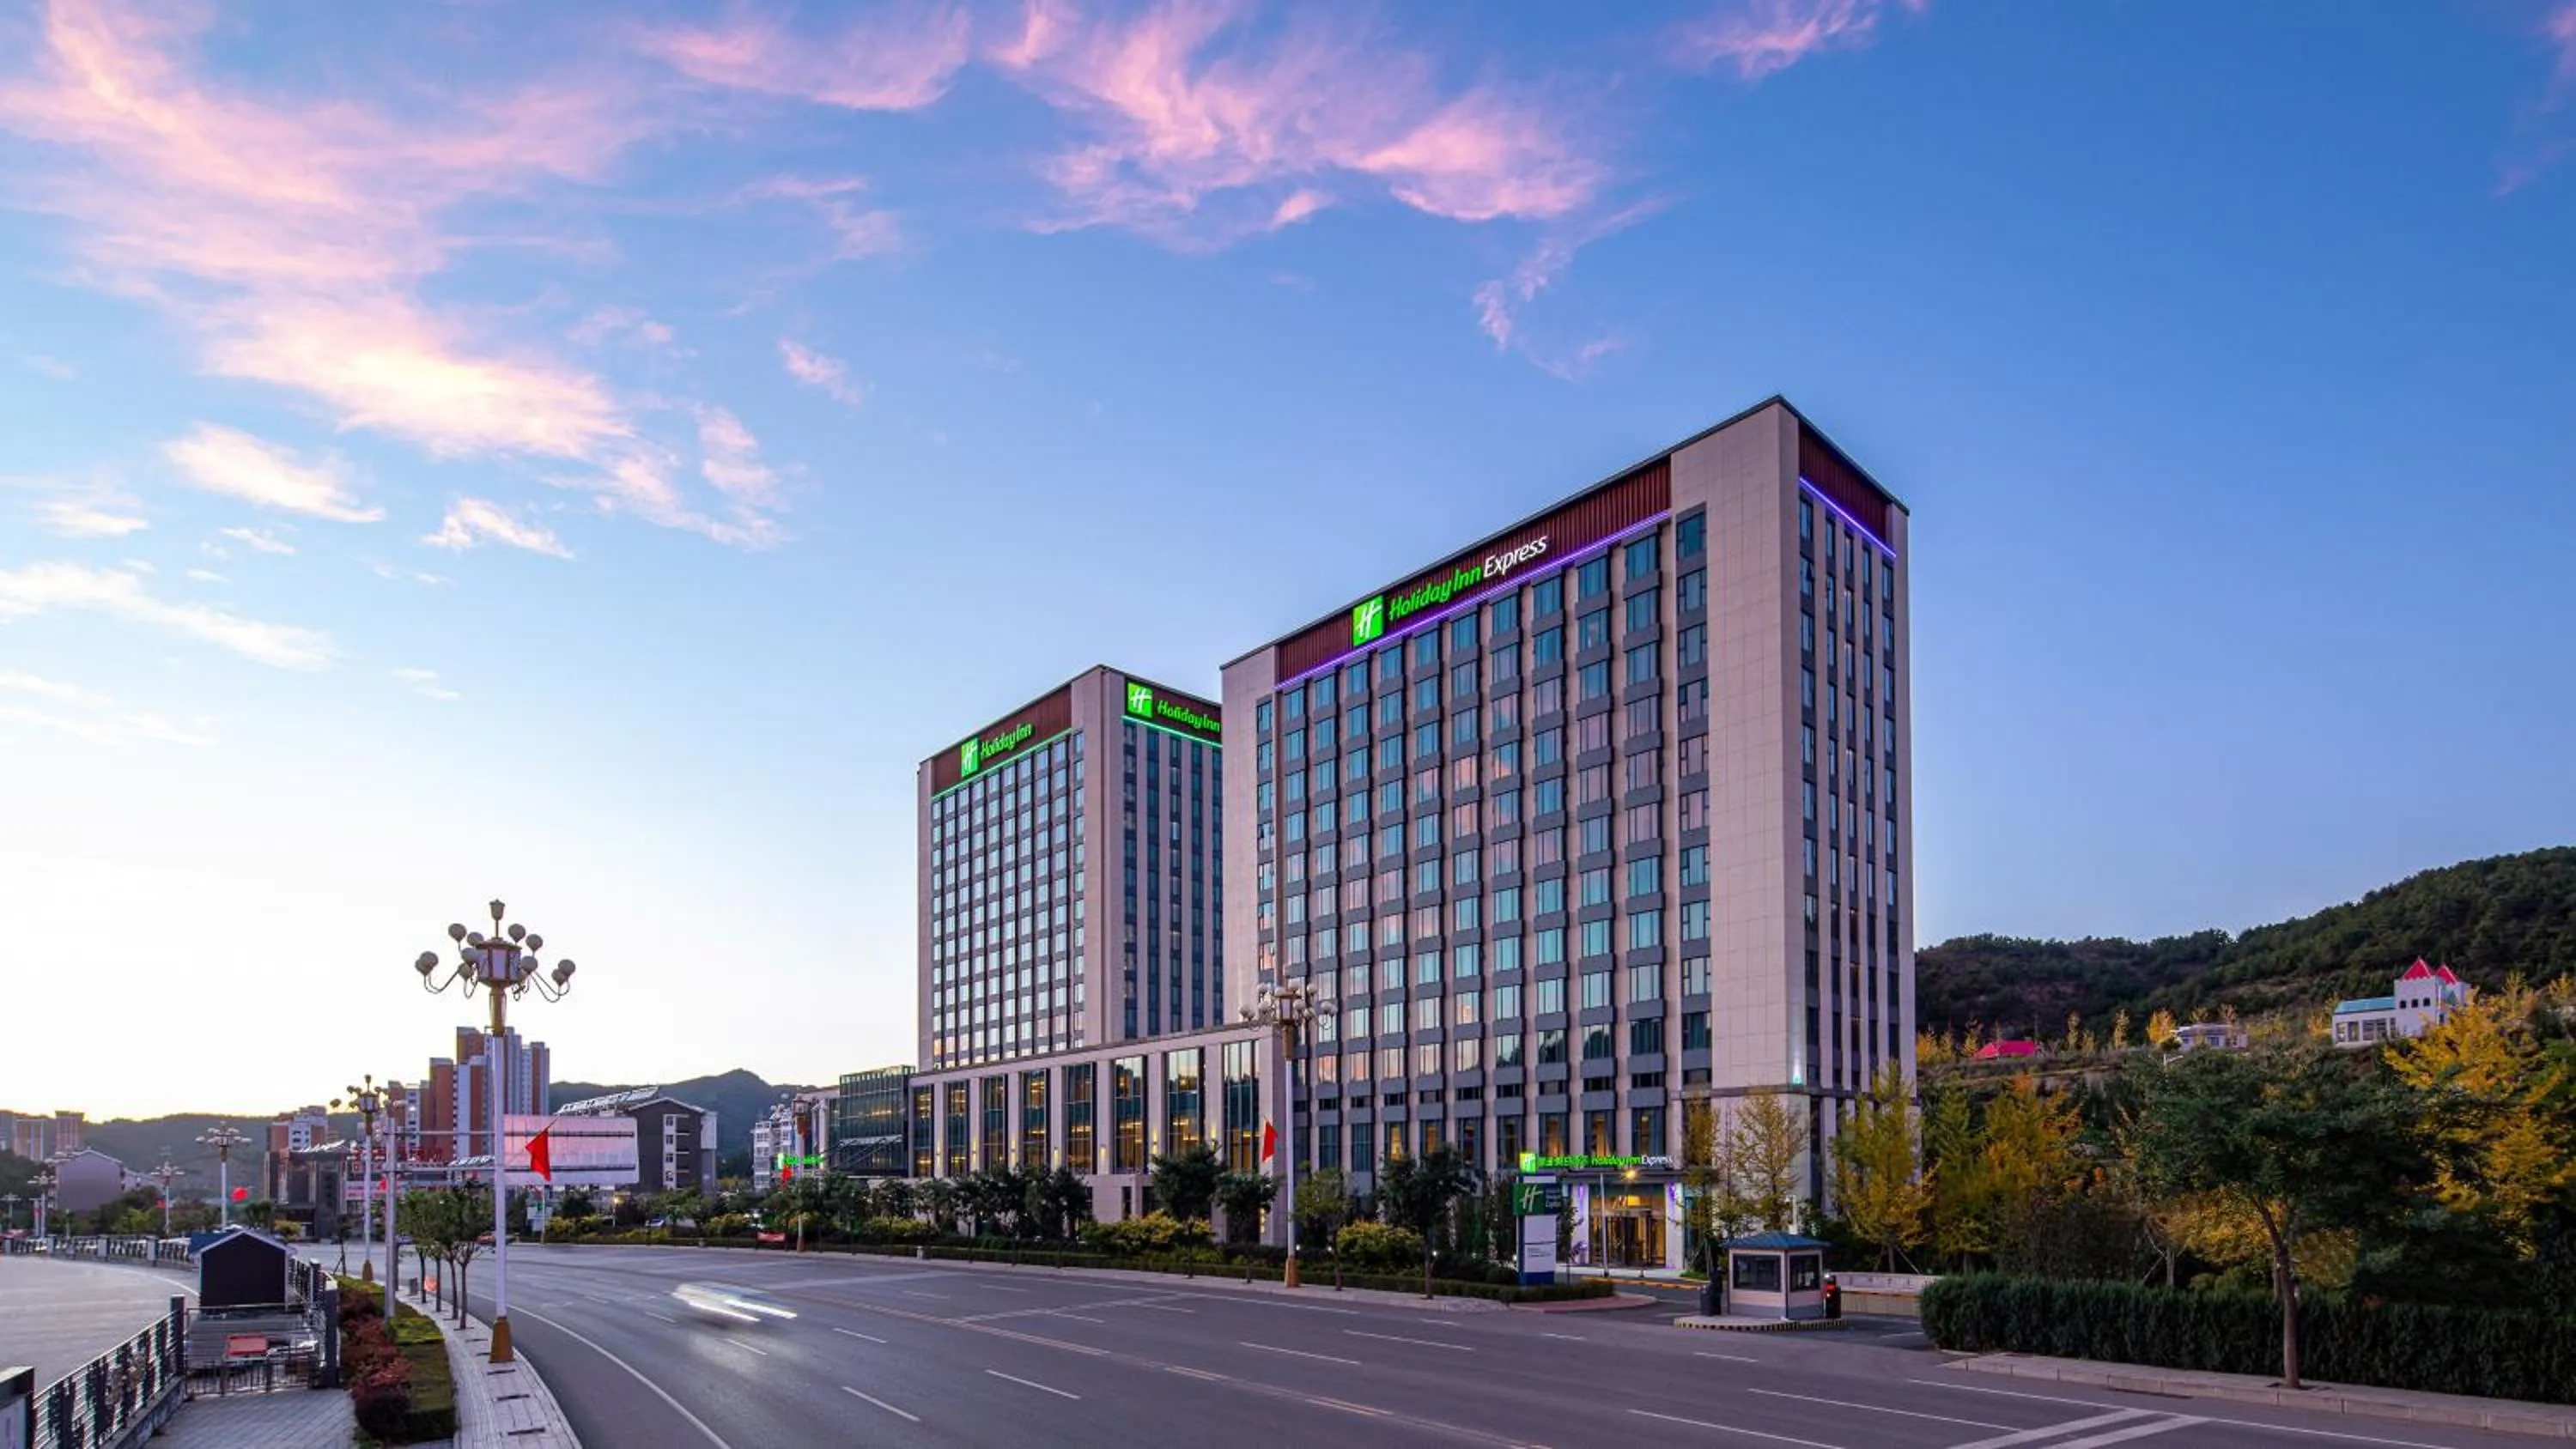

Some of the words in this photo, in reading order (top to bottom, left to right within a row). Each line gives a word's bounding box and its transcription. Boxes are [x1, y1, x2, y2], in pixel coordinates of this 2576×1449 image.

[1388, 579, 1452, 621] Holiday
[1454, 566, 1481, 592] Inn
[1483, 535, 1548, 578] Express
[1157, 700, 1203, 730] Holiday
[1203, 713, 1220, 733] Inn
[981, 731, 1016, 761] Holiday
[1017, 724, 1031, 742] Inn
